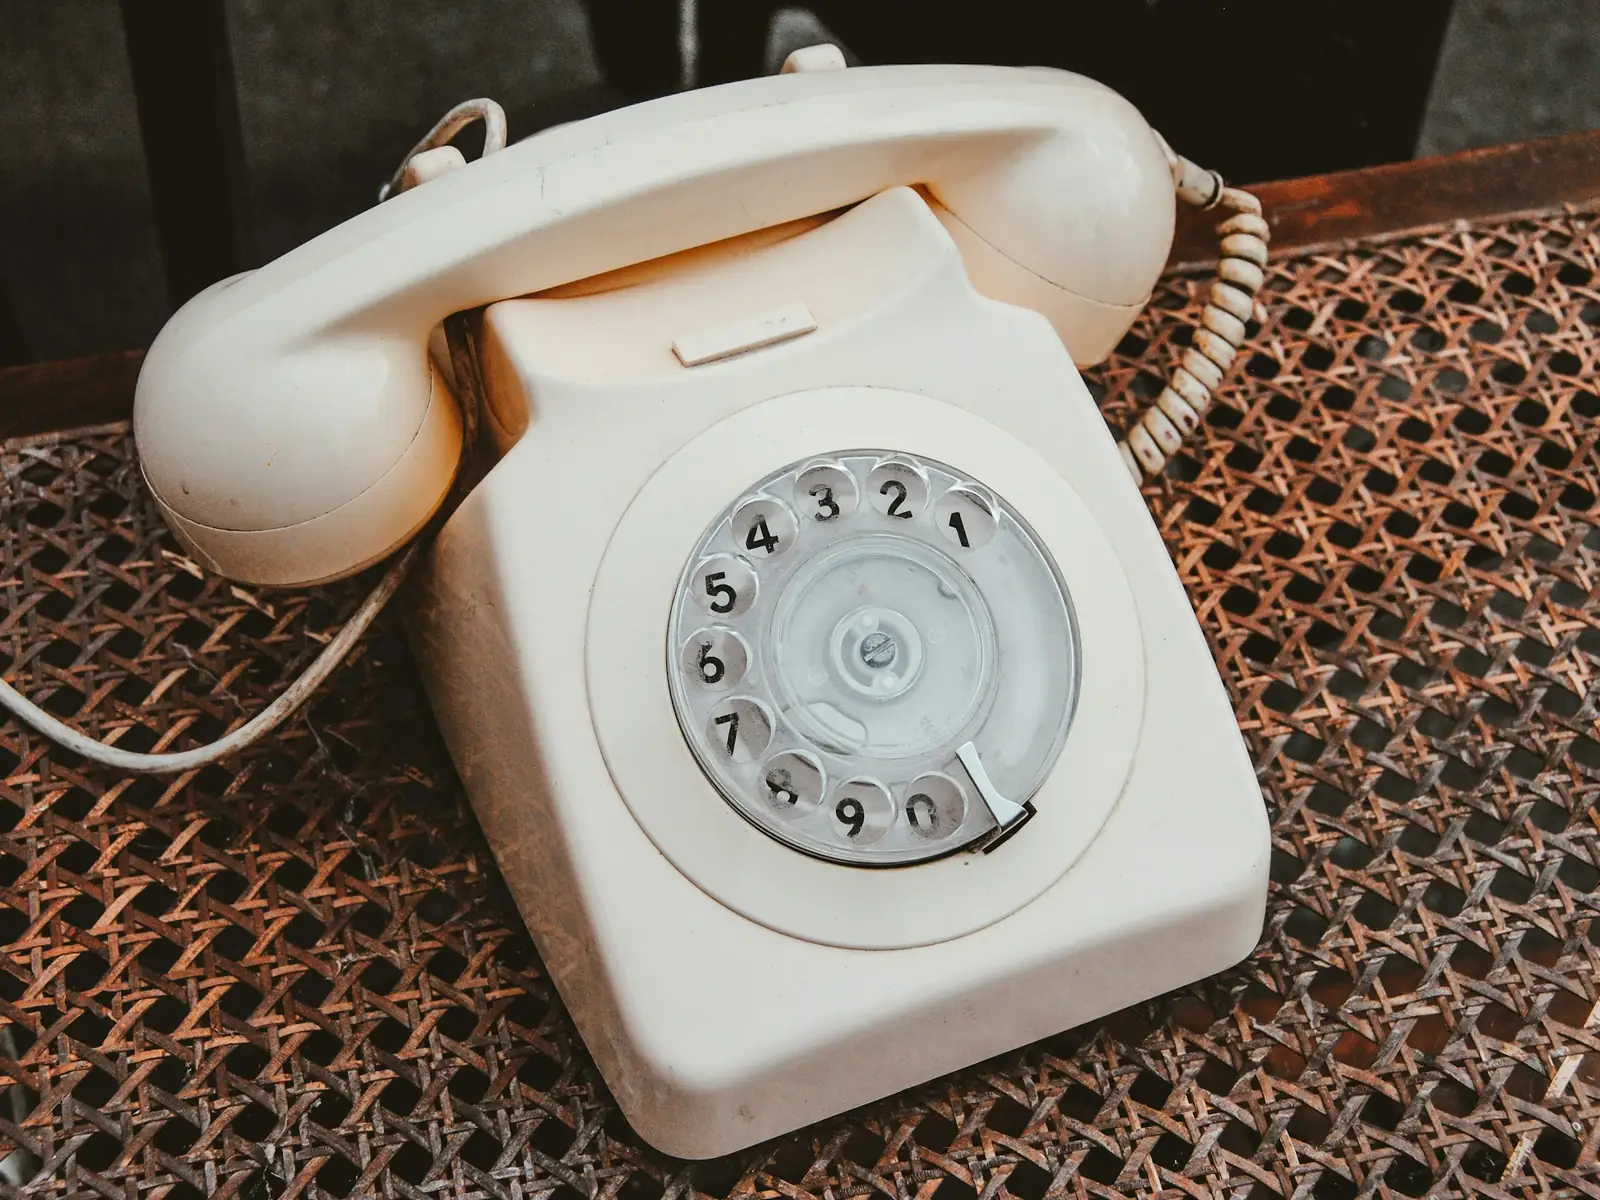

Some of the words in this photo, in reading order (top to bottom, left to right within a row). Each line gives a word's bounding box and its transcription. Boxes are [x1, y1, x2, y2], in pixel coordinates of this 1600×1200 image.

[809, 484, 840, 522] 3
[879, 480, 913, 519] 2
[745, 514, 779, 554] 4
[948, 511, 970, 548] 1
[705, 571, 737, 613] 5
[698, 641, 725, 684] 6
[715, 712, 738, 756] 7
[835, 797, 865, 838] 9
[905, 793, 938, 837] 0
